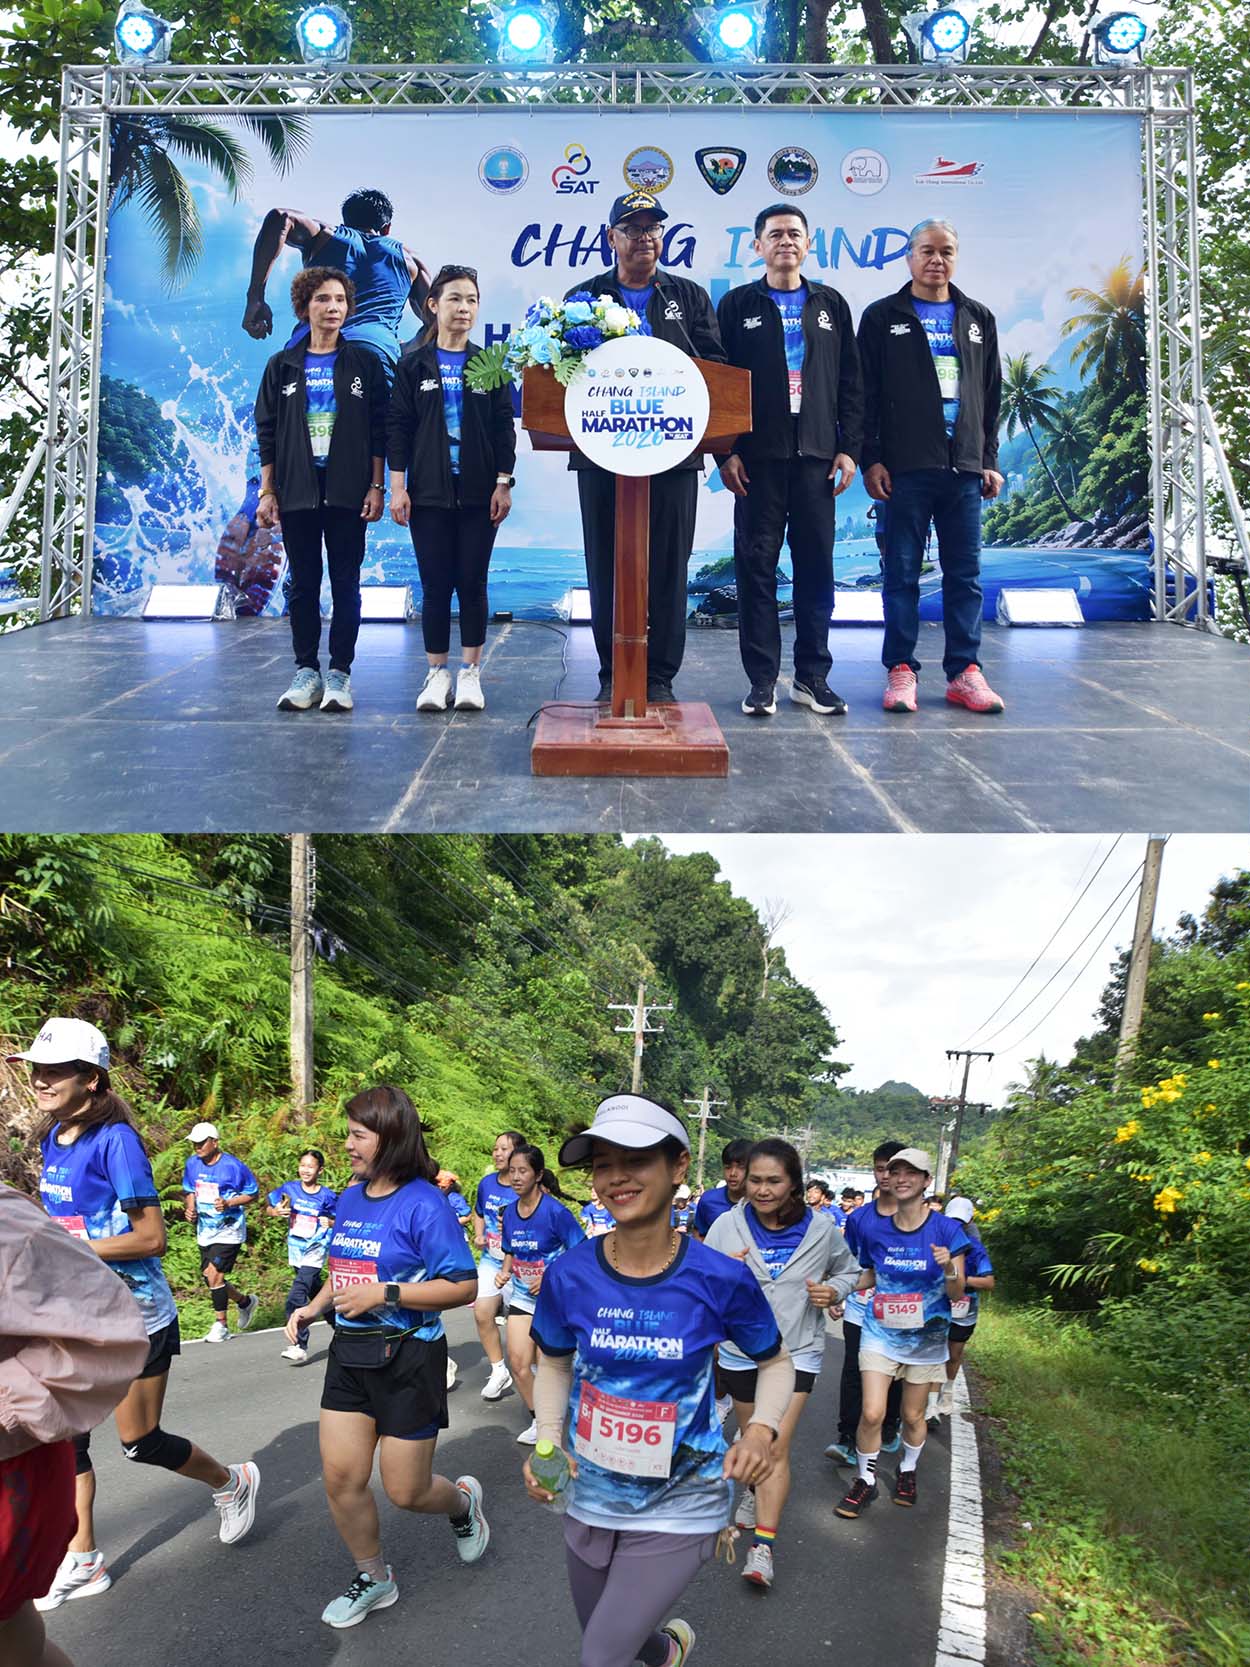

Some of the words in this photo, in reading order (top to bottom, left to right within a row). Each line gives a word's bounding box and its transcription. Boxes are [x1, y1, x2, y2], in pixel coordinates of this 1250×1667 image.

[555, 179, 600, 194] SAT
[511, 223, 697, 269] CHAG
[588, 386, 633, 397] CHANG
[640, 386, 686, 397] ISLAND
[610, 399, 664, 415] BLUE
[582, 417, 693, 433] MARATHON
[612, 429, 664, 449] 2026
[332, 1235, 381, 1253] MARATHON
[884, 1258, 927, 1269] MARATHON
[597, 1307, 634, 1319] CHANG
[888, 1304, 917, 1314] 5149
[591, 1334, 683, 1353] MARATHON
[614, 1347, 657, 1361] 2026
[661, 1407, 669, 1417] F
[600, 1416, 662, 1446] 5196
